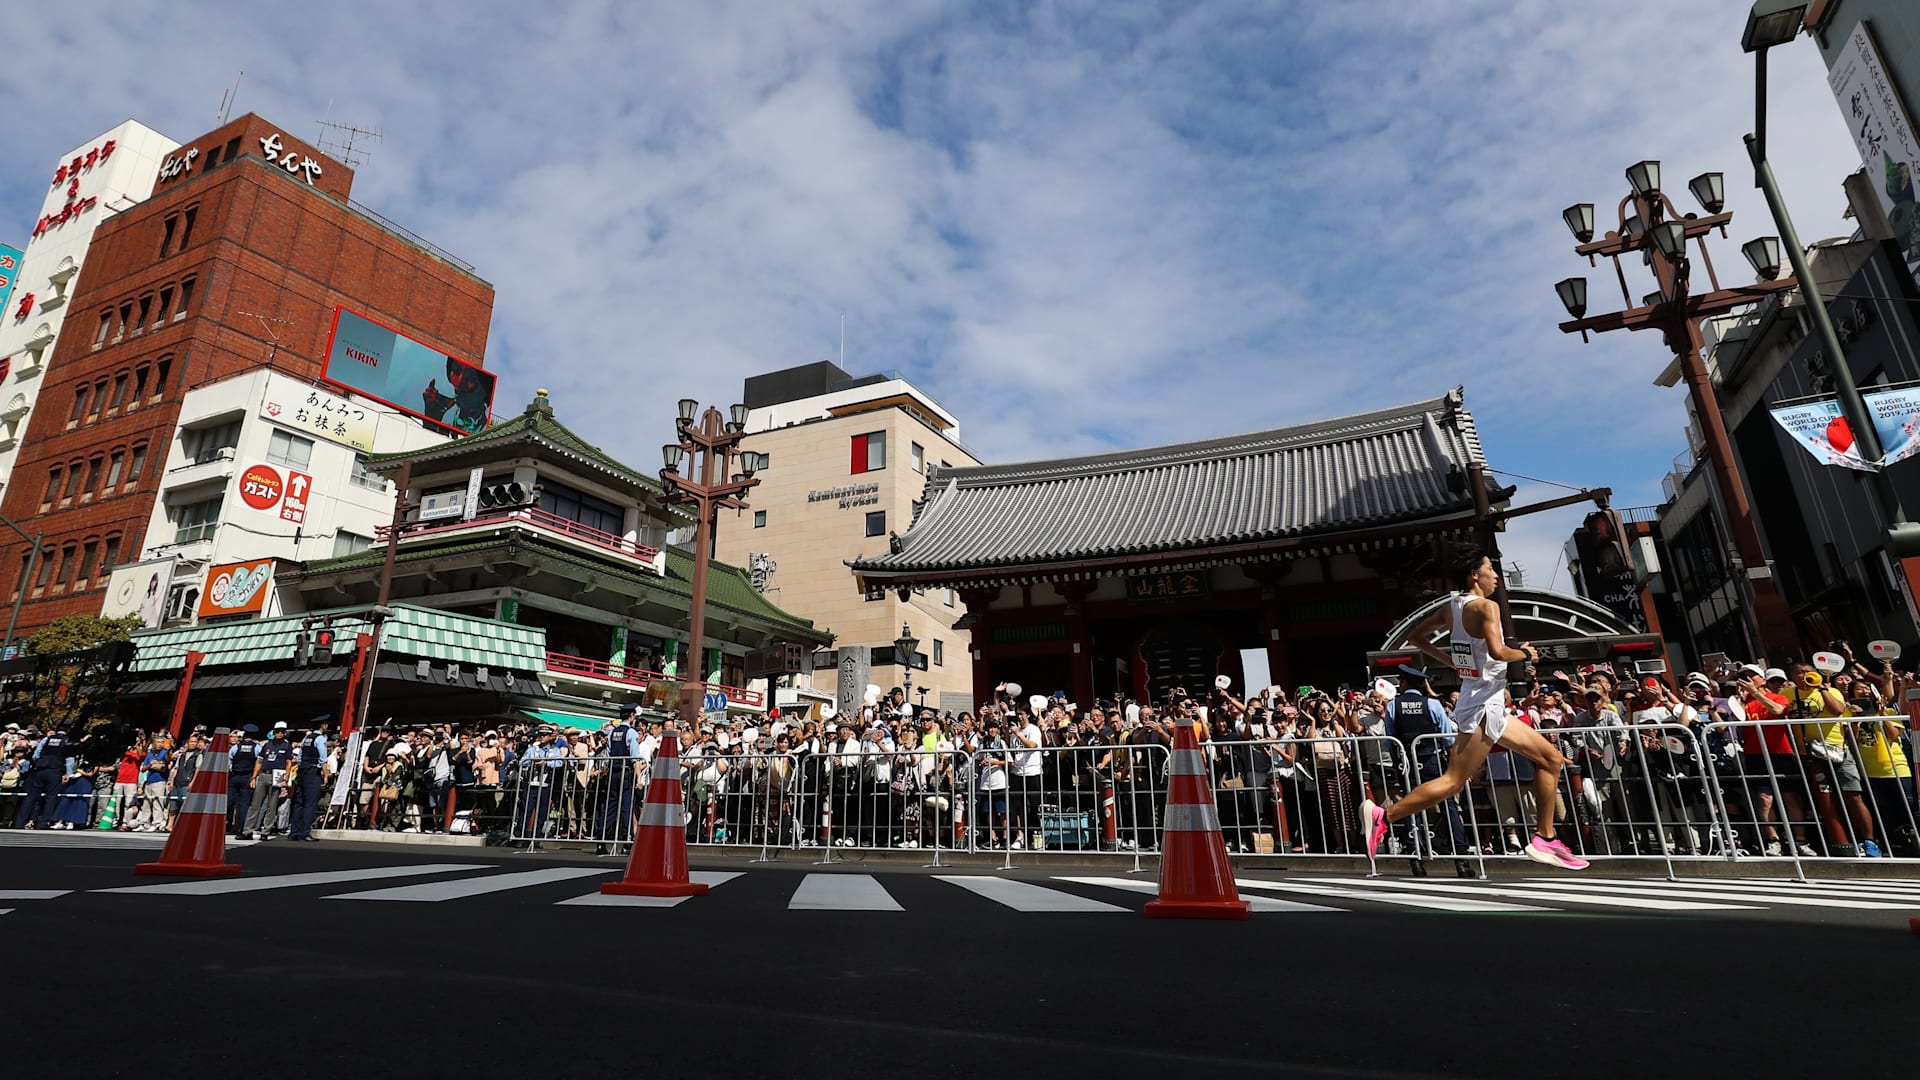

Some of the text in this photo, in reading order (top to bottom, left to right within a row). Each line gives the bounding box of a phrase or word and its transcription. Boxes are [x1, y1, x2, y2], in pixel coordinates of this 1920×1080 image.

[53, 140, 116, 185] カラオケ
[159, 147, 199, 183] ちんや
[260, 133, 322, 186] ちんや
[345, 347, 378, 368] KIRIN
[306, 391, 365, 421] あんみつ
[1874, 396, 1906, 406] RUGBY
[1876, 402, 1912, 412] WORLD
[295, 407, 347, 436] お抹茶
[1782, 412, 1812, 422] RUGBY
[1878, 410, 1904, 418] 2019,
[1784, 417, 1817, 428] WORLD
[1812, 421, 1841, 430] JAPAN
[243, 481, 279, 500] ガスト
[282, 508, 303, 522] 右側
